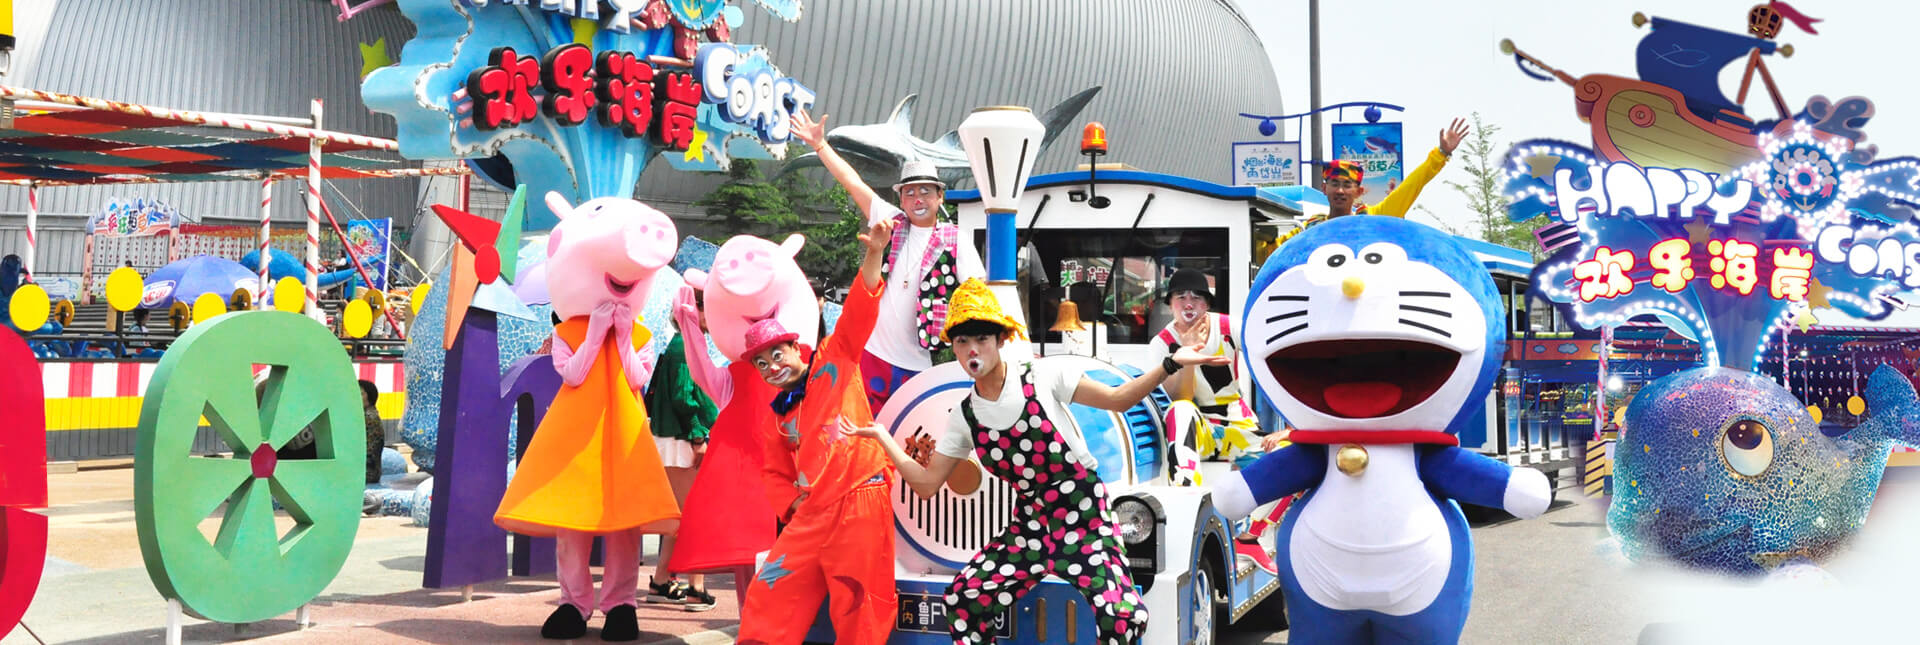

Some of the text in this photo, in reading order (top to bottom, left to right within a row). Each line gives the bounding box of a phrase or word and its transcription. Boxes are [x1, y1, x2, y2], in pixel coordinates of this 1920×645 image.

[469, 43, 700, 151] 欢乐海岸
[697, 43, 816, 143] COAST
[1553, 161, 1754, 225] HAPPY
[1573, 237, 1815, 302] 欢乐海岸
